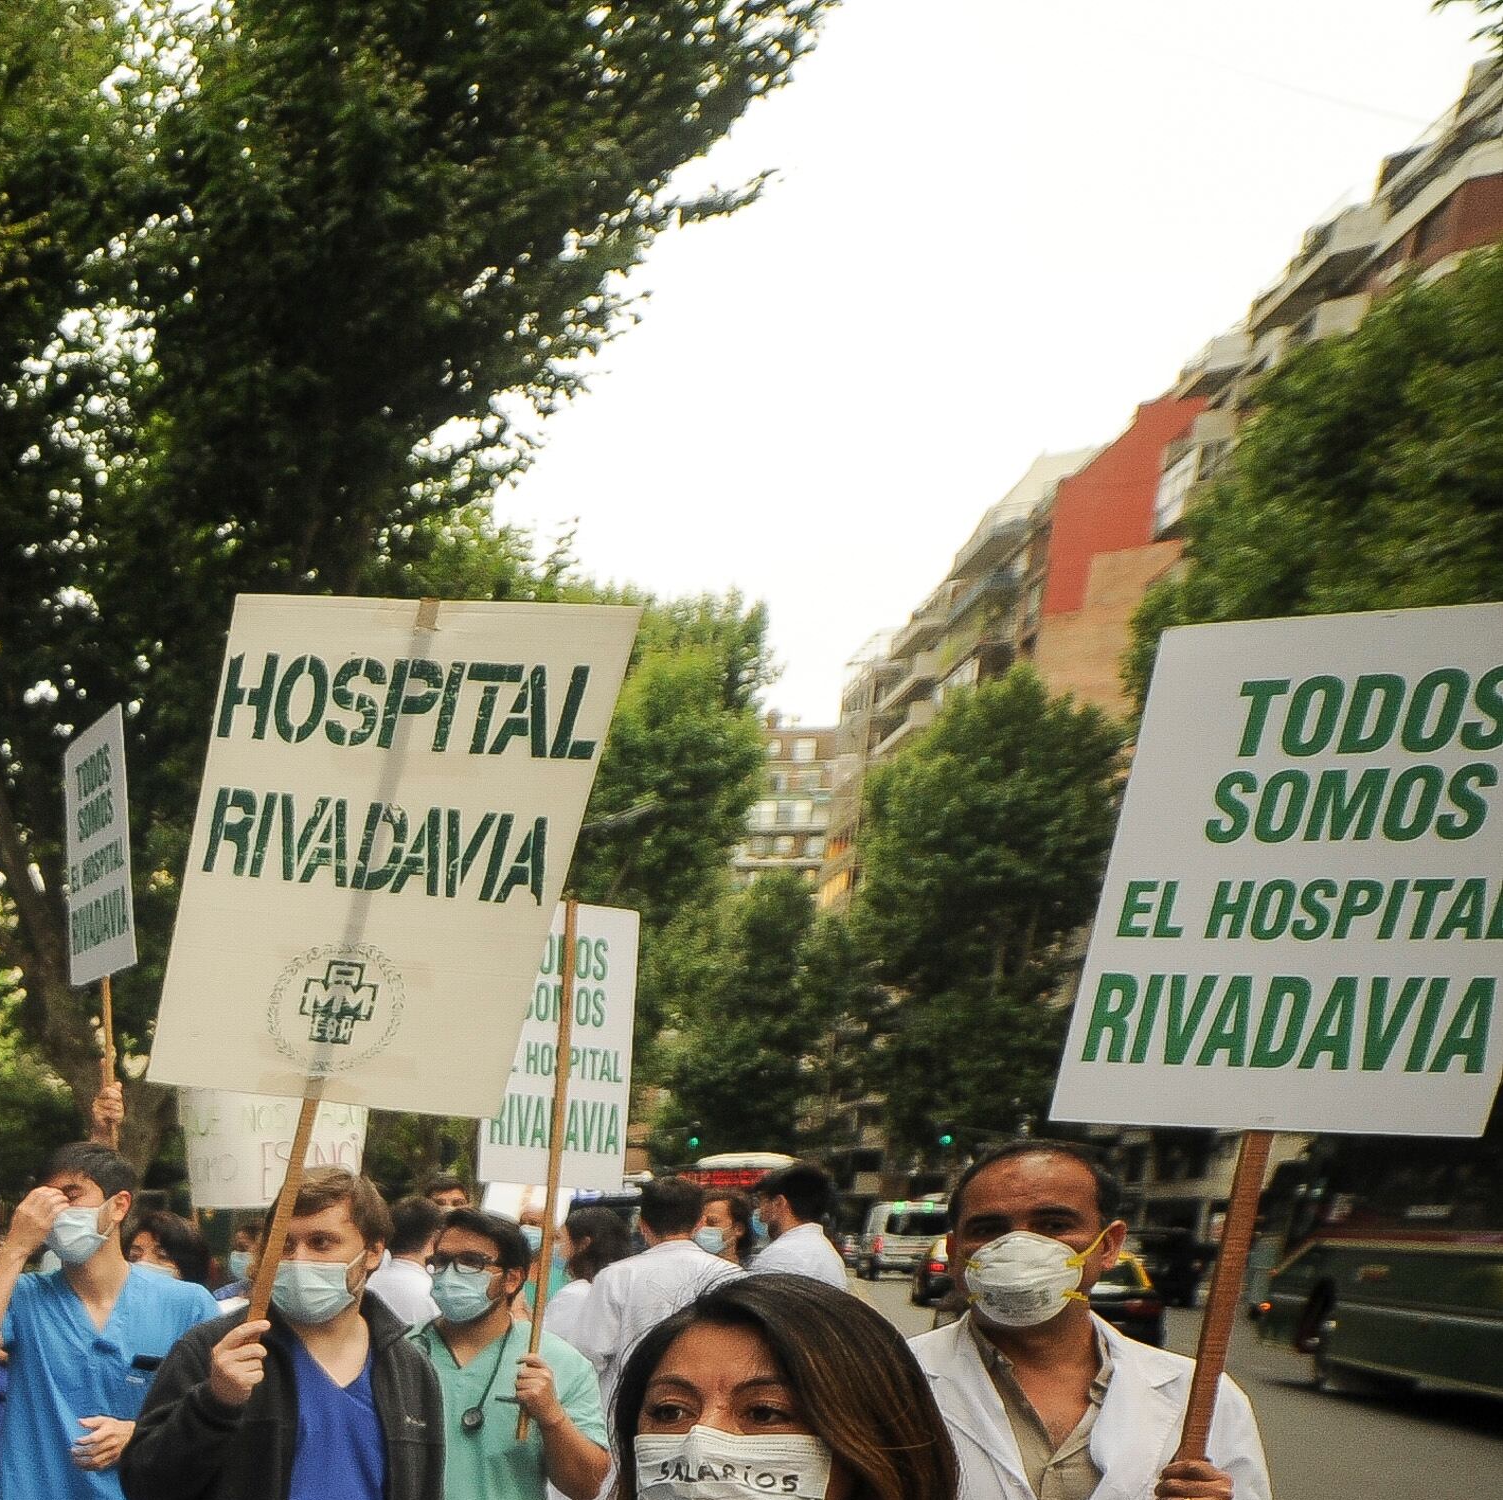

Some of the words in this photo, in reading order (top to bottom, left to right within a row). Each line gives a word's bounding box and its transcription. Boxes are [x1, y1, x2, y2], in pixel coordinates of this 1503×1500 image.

[217, 651, 598, 759] HOSPITAL
[1238, 666, 1503, 757] TODOS
[203, 786, 548, 905] RIVADAVIA
[1205, 763, 1498, 843] SOMOS
[1117, 880, 1184, 938] EL
[526, 1040, 622, 1083] HOPITAL
[1081, 973, 1496, 1074] RIVADAVIA
